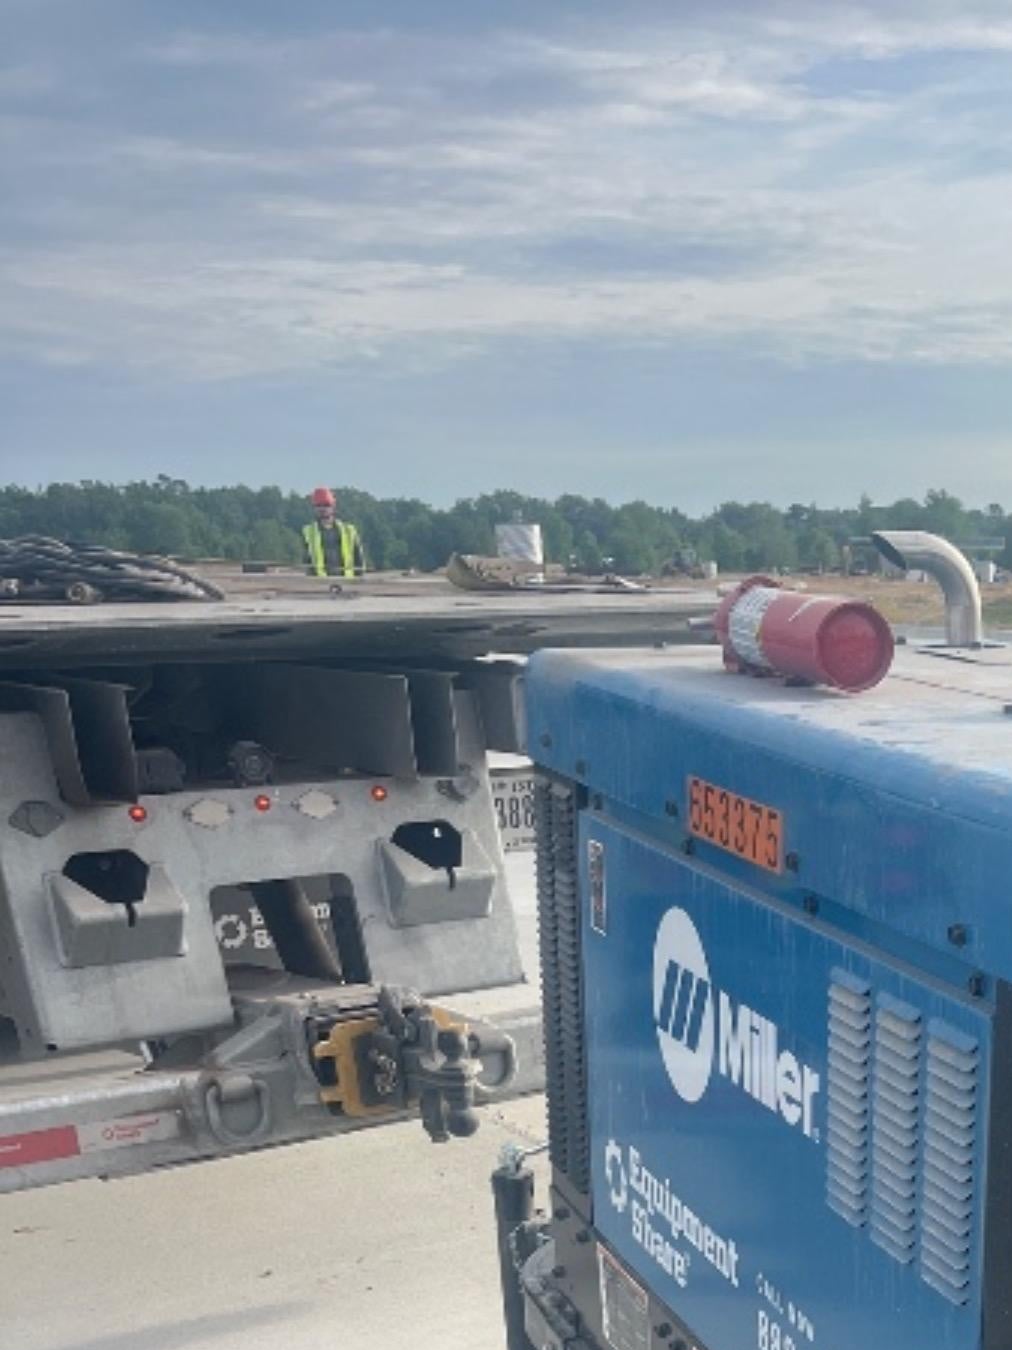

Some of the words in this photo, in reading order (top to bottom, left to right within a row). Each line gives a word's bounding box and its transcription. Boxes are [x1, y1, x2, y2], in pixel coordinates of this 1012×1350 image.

[691, 779, 778, 868] 653375
[719, 990, 820, 1143] Miller
[629, 1146, 739, 1288] Equipment
[632, 1200, 687, 1288] Share
